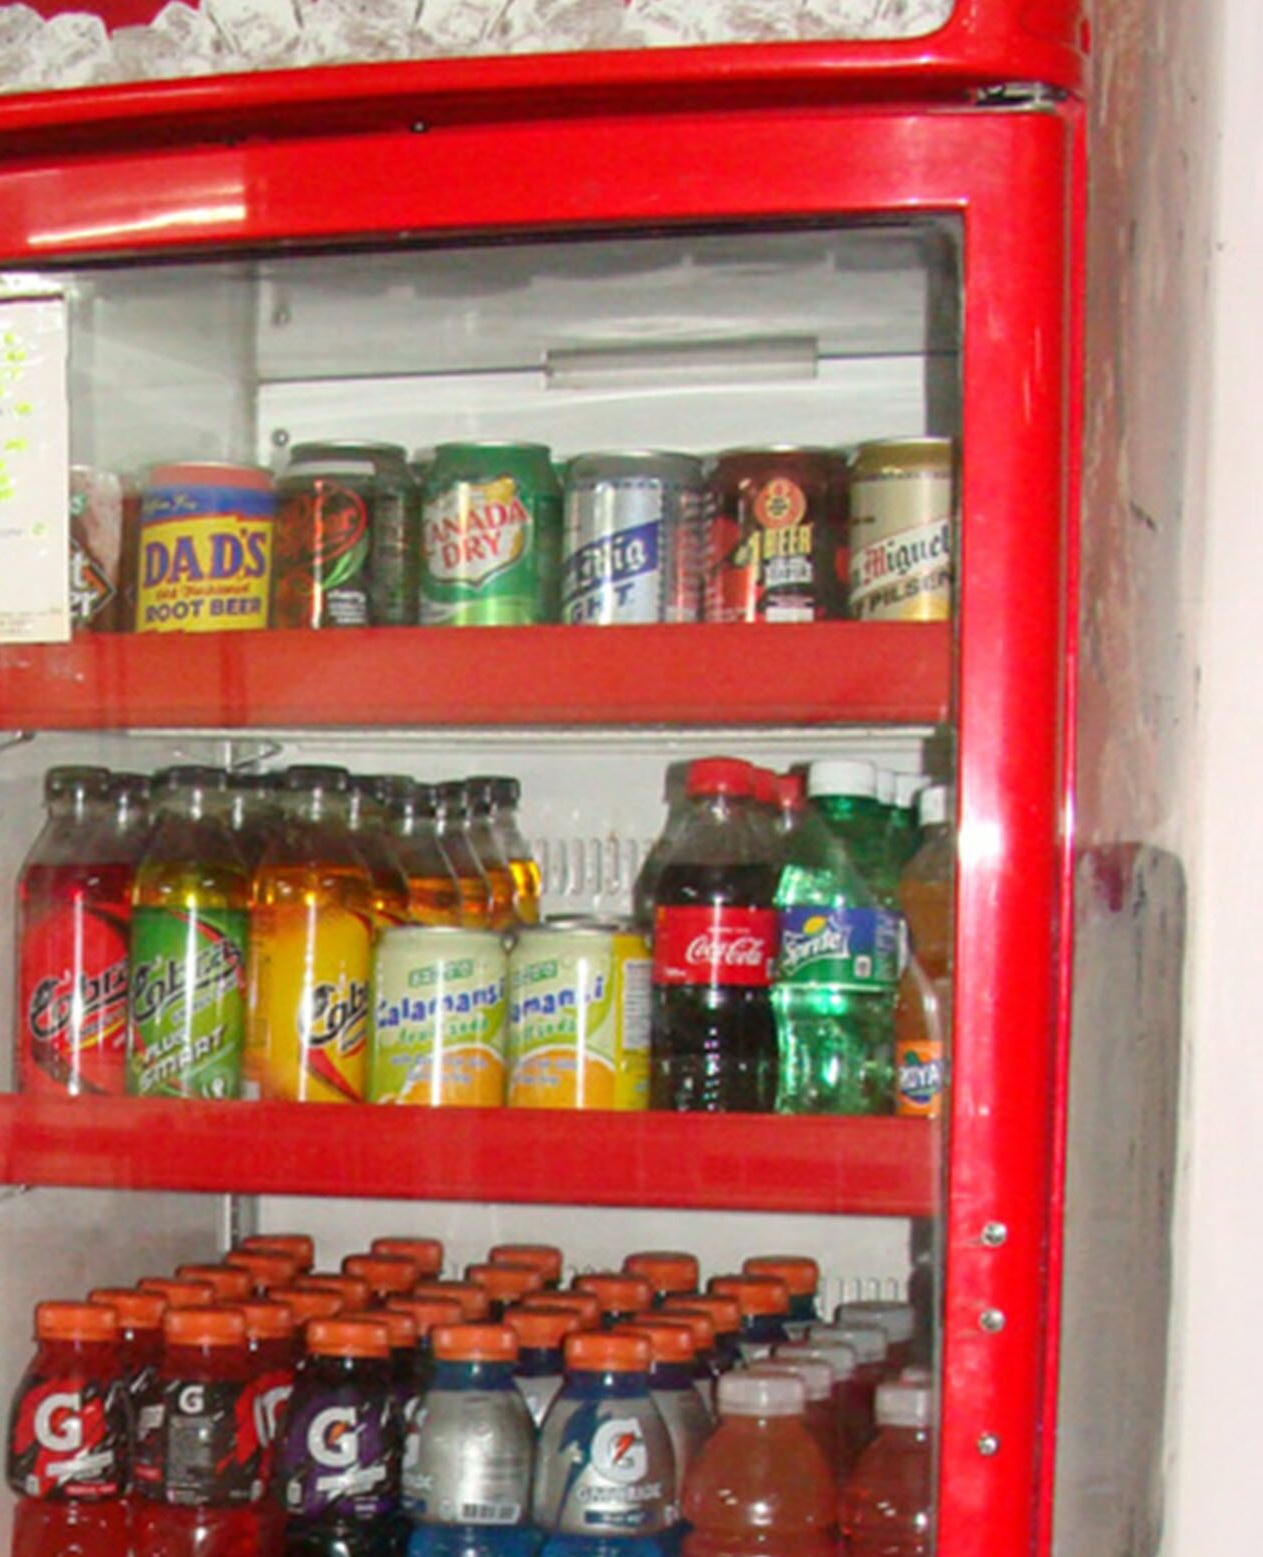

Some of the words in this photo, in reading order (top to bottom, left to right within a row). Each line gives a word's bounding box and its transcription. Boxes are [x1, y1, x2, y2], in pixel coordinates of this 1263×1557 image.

[143, 528, 267, 591] DAD'S
[441, 530, 501, 570] DRY
[864, 524, 950, 586] Miguel
[145, 599, 203, 623] ROOT
[209, 596, 262, 617] BEER
[299, 978, 368, 1048] Cob
[35, 1394, 82, 1451] G
[178, 1386, 205, 1413] G
[307, 1407, 359, 1467] G
[591, 1418, 648, 1484] G
